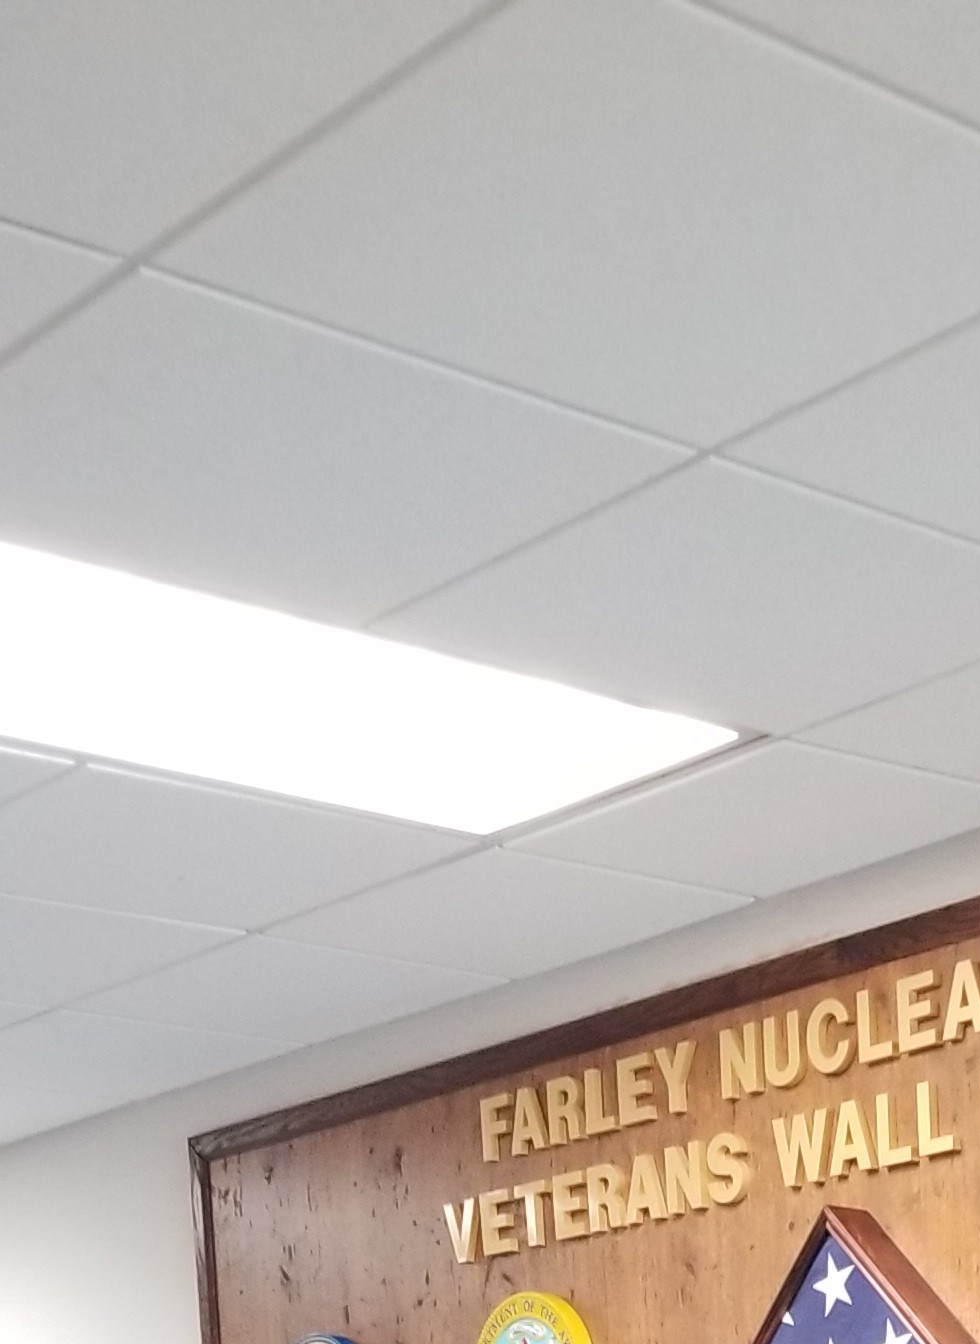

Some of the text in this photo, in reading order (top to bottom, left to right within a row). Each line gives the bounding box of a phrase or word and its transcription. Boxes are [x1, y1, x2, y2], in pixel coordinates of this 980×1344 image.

[479, 1039, 699, 1164] FARLEY
[443, 1131, 750, 1264] VETERANS
[771, 1081, 962, 1189] WALL
[540, 1304, 558, 1325] THE
